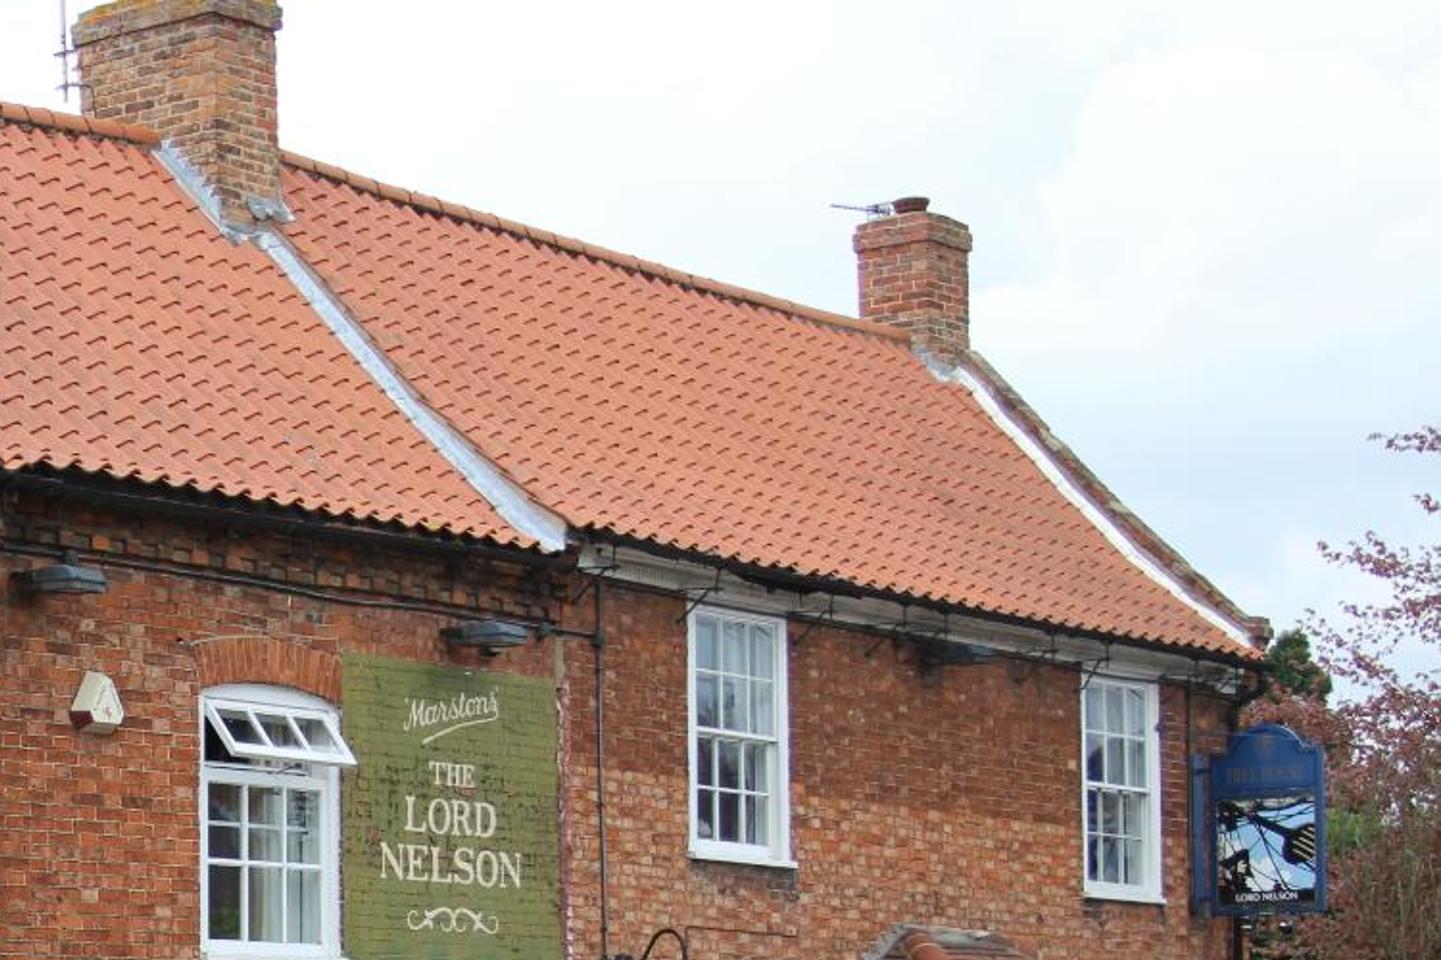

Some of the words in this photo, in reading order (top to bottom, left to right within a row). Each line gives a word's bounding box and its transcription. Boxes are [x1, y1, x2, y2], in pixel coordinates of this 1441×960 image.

[429, 761, 476, 788] THE
[405, 796, 497, 838] LORD
[380, 842, 521, 889] NELSON
[1235, 892, 1261, 902] LORD
[1262, 890, 1298, 901] NELSON
